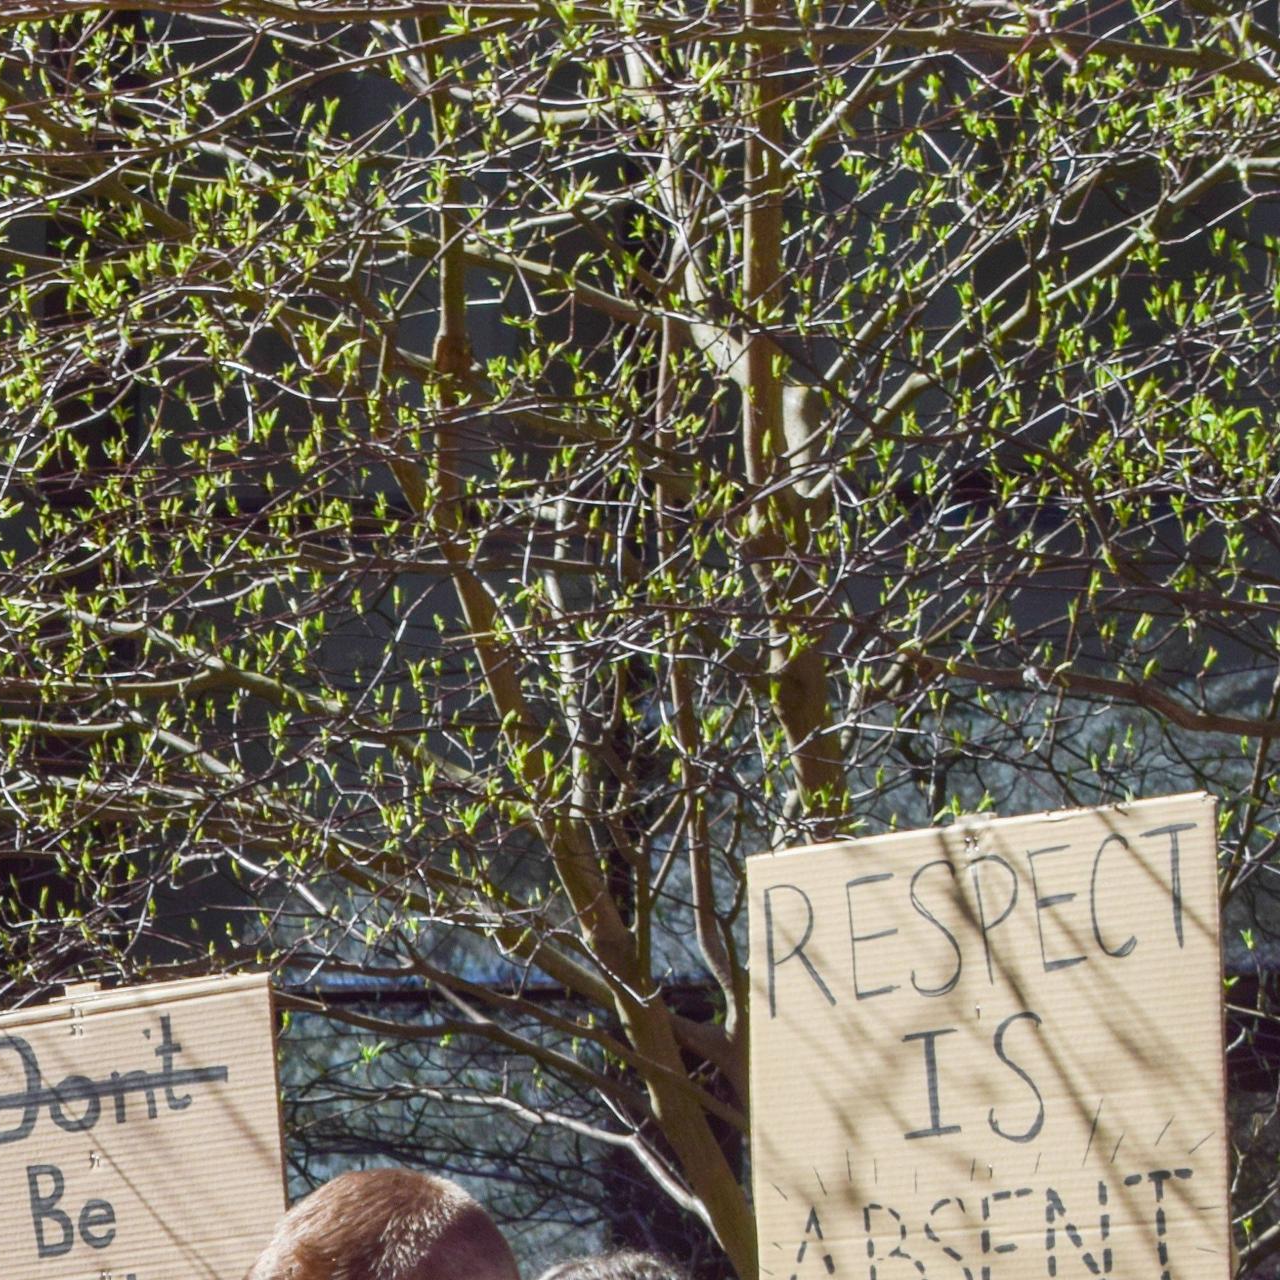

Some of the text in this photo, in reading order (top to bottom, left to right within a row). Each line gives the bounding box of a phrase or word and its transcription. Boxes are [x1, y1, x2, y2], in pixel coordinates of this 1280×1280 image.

[763, 822, 1197, 1019] RESPECT
[902, 1011, 1046, 1144] IS
[26, 1163, 117, 1259] Be
